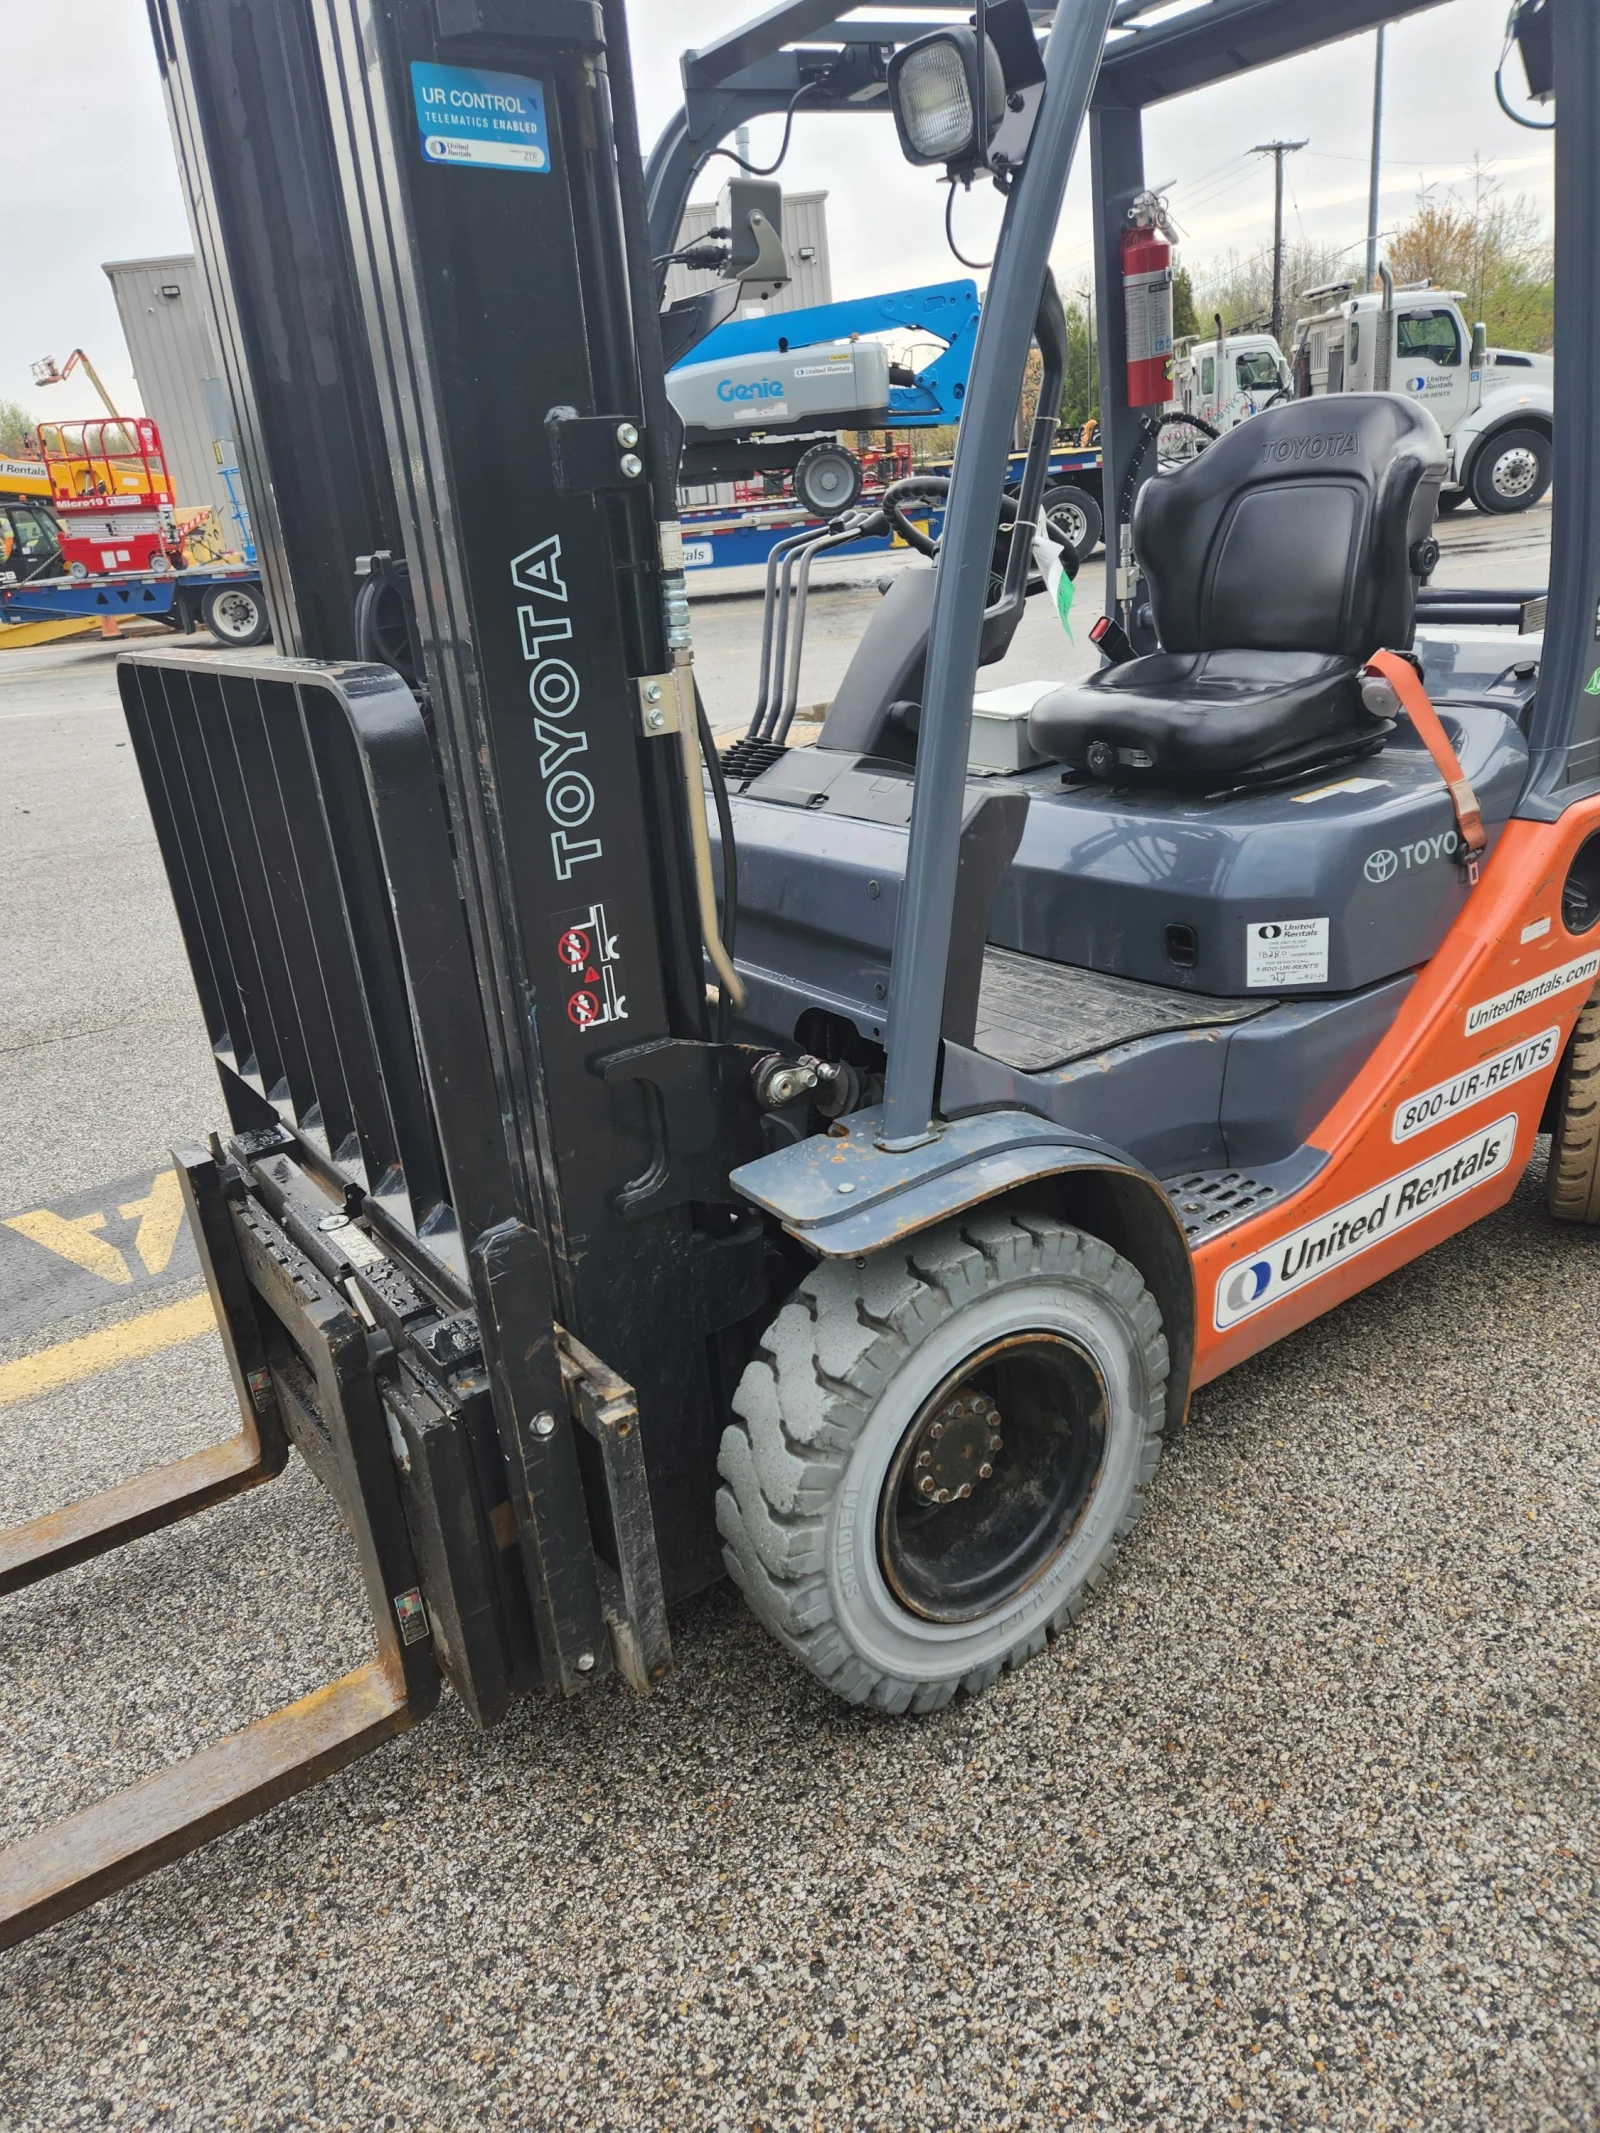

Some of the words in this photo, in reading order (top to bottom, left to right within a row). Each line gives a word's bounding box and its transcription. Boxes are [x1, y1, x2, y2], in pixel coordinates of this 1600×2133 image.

[422, 87, 446, 105] UR
[450, 90, 526, 114] CONTROL
[424, 112, 488, 128] TELEMATICS
[494, 119, 538, 134] ENABLED
[447, 142, 469, 151] United
[448, 150, 472, 158] Rentals
[805, 367, 827, 375] United
[1426, 374, 1453, 383] United
[717, 377, 784, 403] Genie
[1426, 381, 1453, 390] Rentals
[1262, 431, 1359, 463] TOYOTA
[7, 464, 46, 476] Rentals
[56, 498, 104, 508] Micro19
[510, 534, 603, 880] TOYOTA
[1400, 830, 1459, 869] TOYO
[1284, 922, 1316, 930] United
[1284, 930, 1318, 938] Rentals
[1469, 958, 1597, 1030] UnitedRentals.com
[1402, 1038, 1552, 1130] 800-UR-RENTS
[1280, 1193, 1391, 1282] United
[1395, 1137, 1501, 1219] Rentals
[837, 1476, 862, 1600] SOLIDEAL
